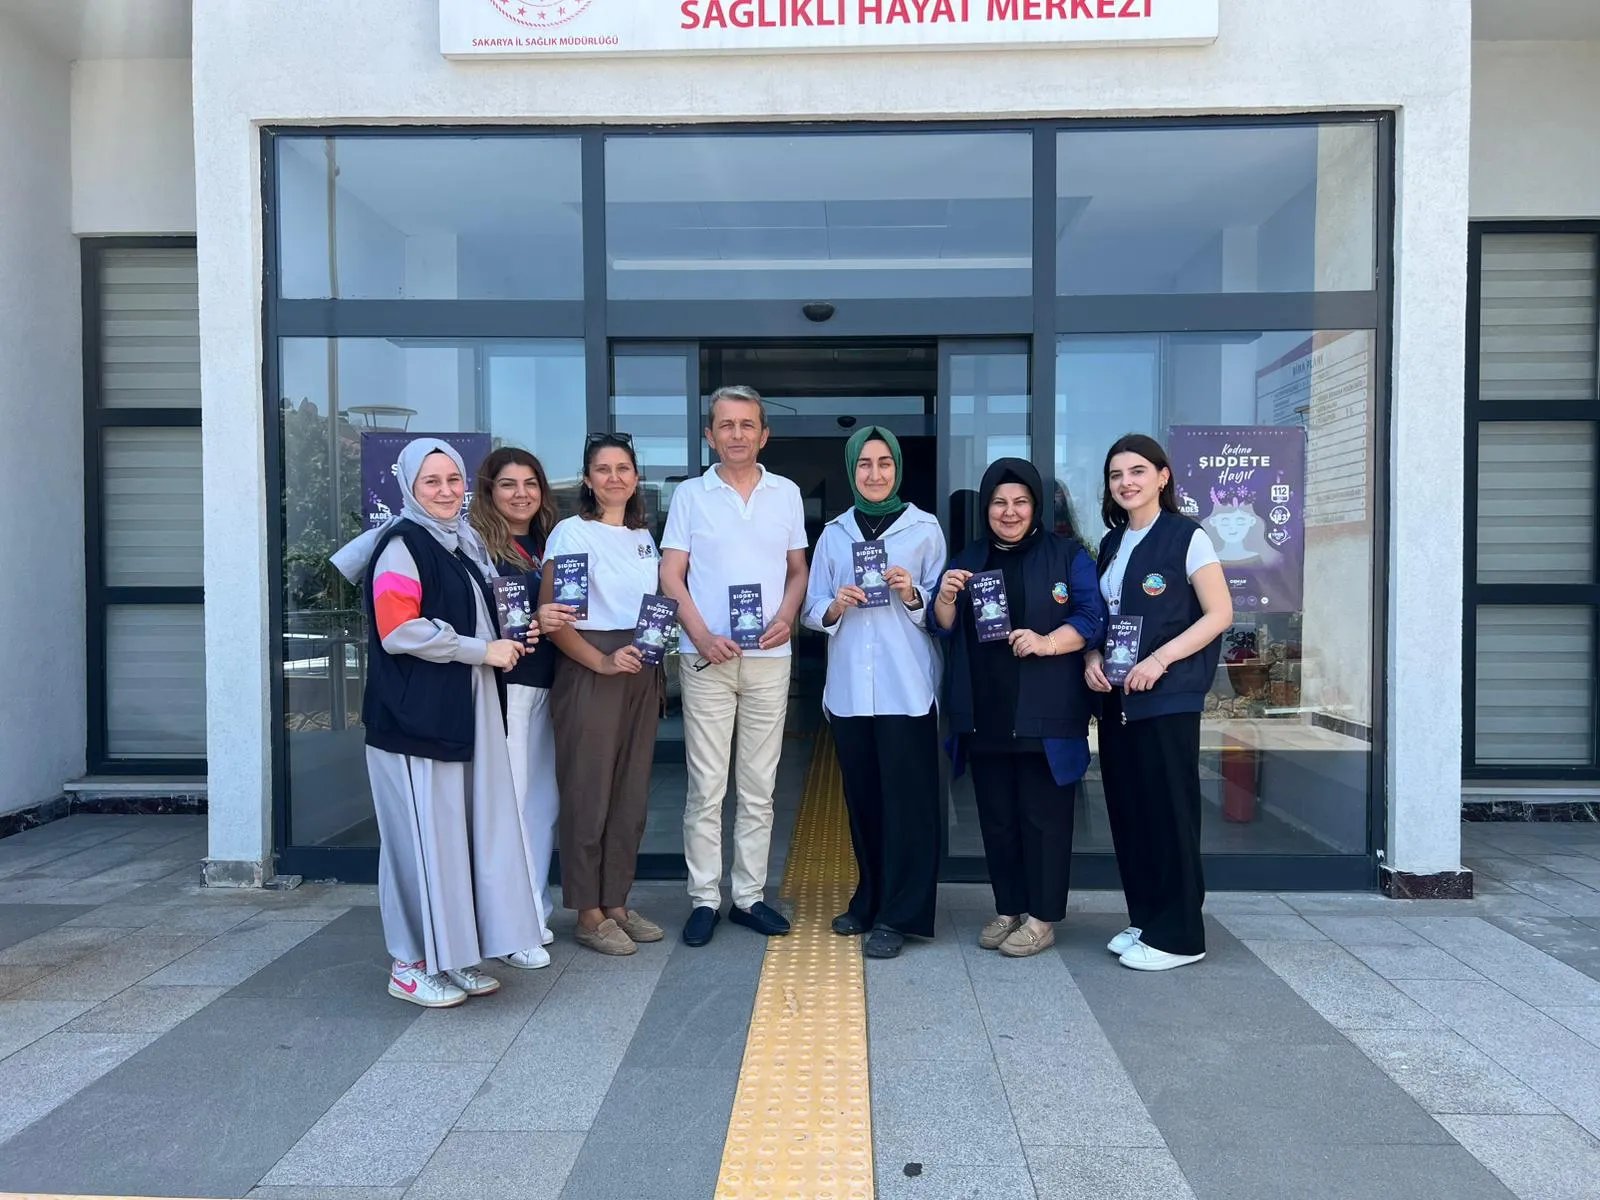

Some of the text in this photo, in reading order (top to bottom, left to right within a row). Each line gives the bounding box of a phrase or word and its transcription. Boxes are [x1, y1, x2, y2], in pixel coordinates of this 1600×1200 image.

[472, 35, 619, 47] SAKARYA İL SAĞLIK MÜDÜRLÜĞÜ
[1199, 456, 1270, 469] ŞİDDETE
[1218, 467, 1255, 485] Hayır
[1273, 487, 1287, 495] 112
